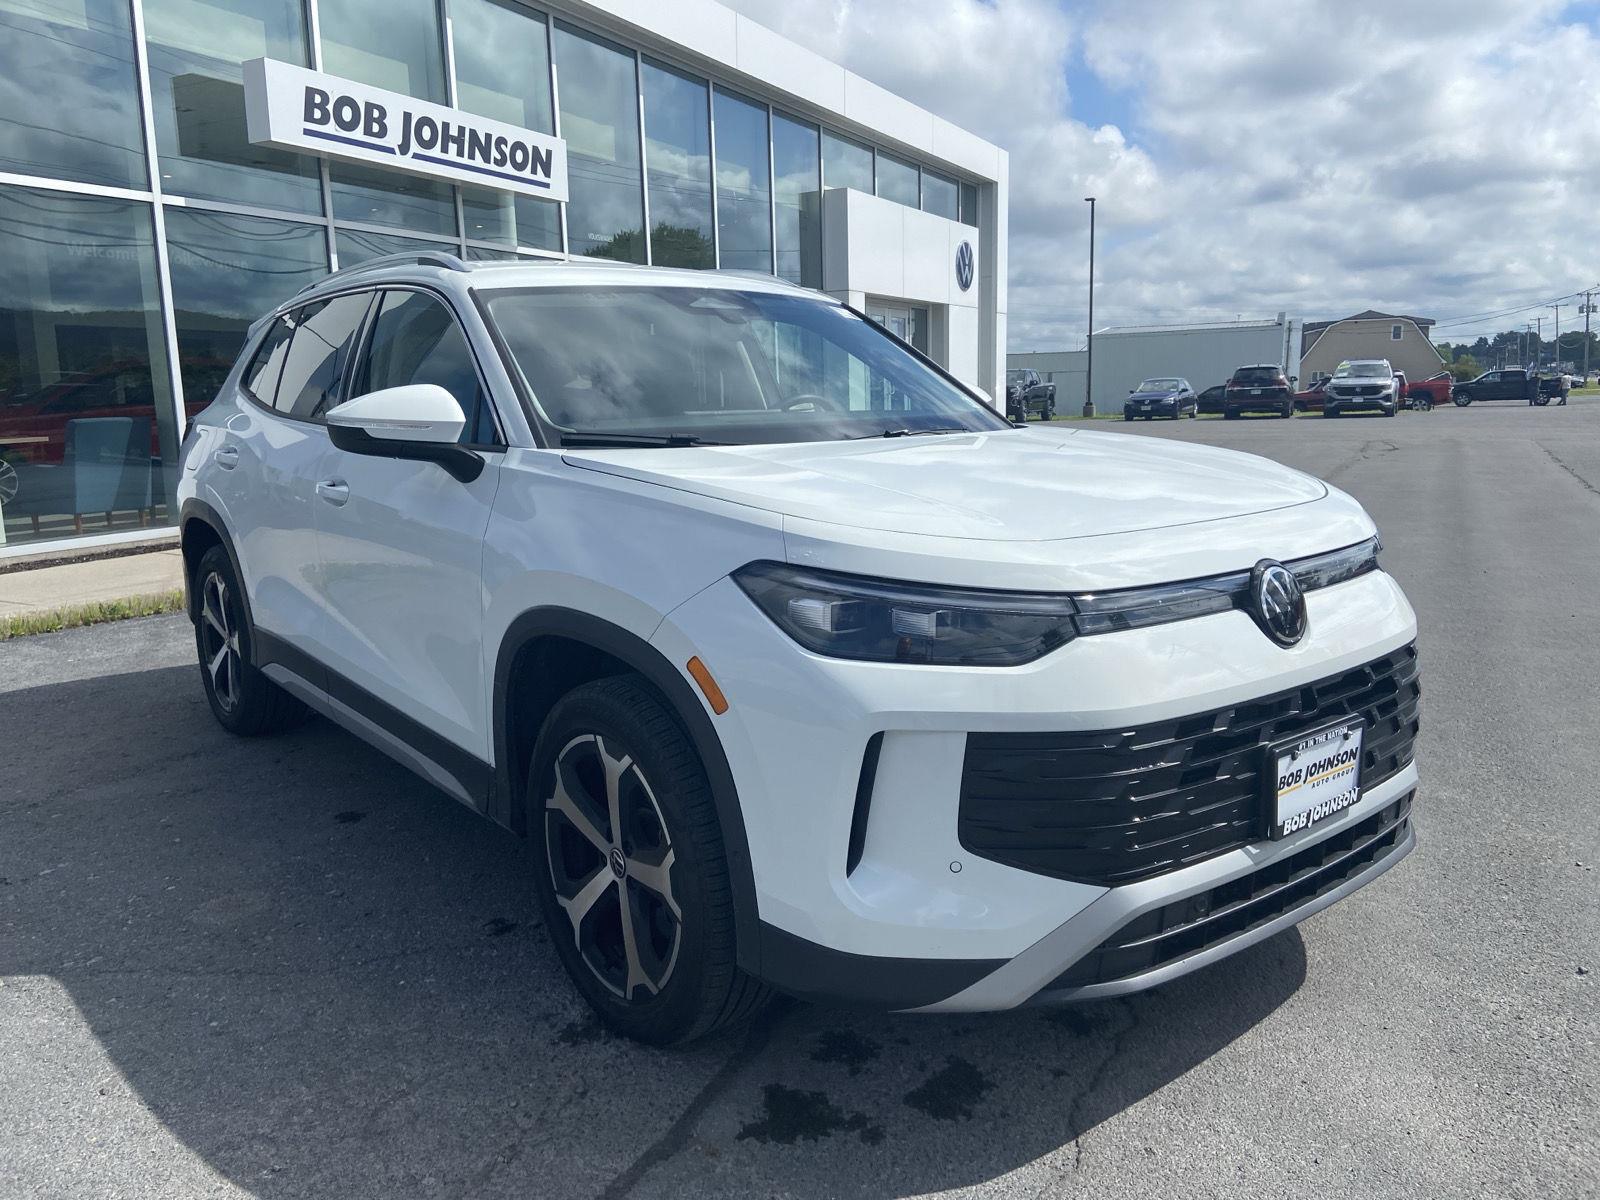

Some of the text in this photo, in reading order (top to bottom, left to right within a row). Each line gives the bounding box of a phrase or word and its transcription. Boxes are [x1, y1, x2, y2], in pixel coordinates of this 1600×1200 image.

[303, 86, 553, 179] BOB JOHNSON
[1315, 734, 1327, 745] THE
[1278, 747, 1359, 790] BOB JOHNSON
[1311, 766, 1355, 789] AUTO GROUP
[1283, 786, 1361, 836] BOB JOHNSON
